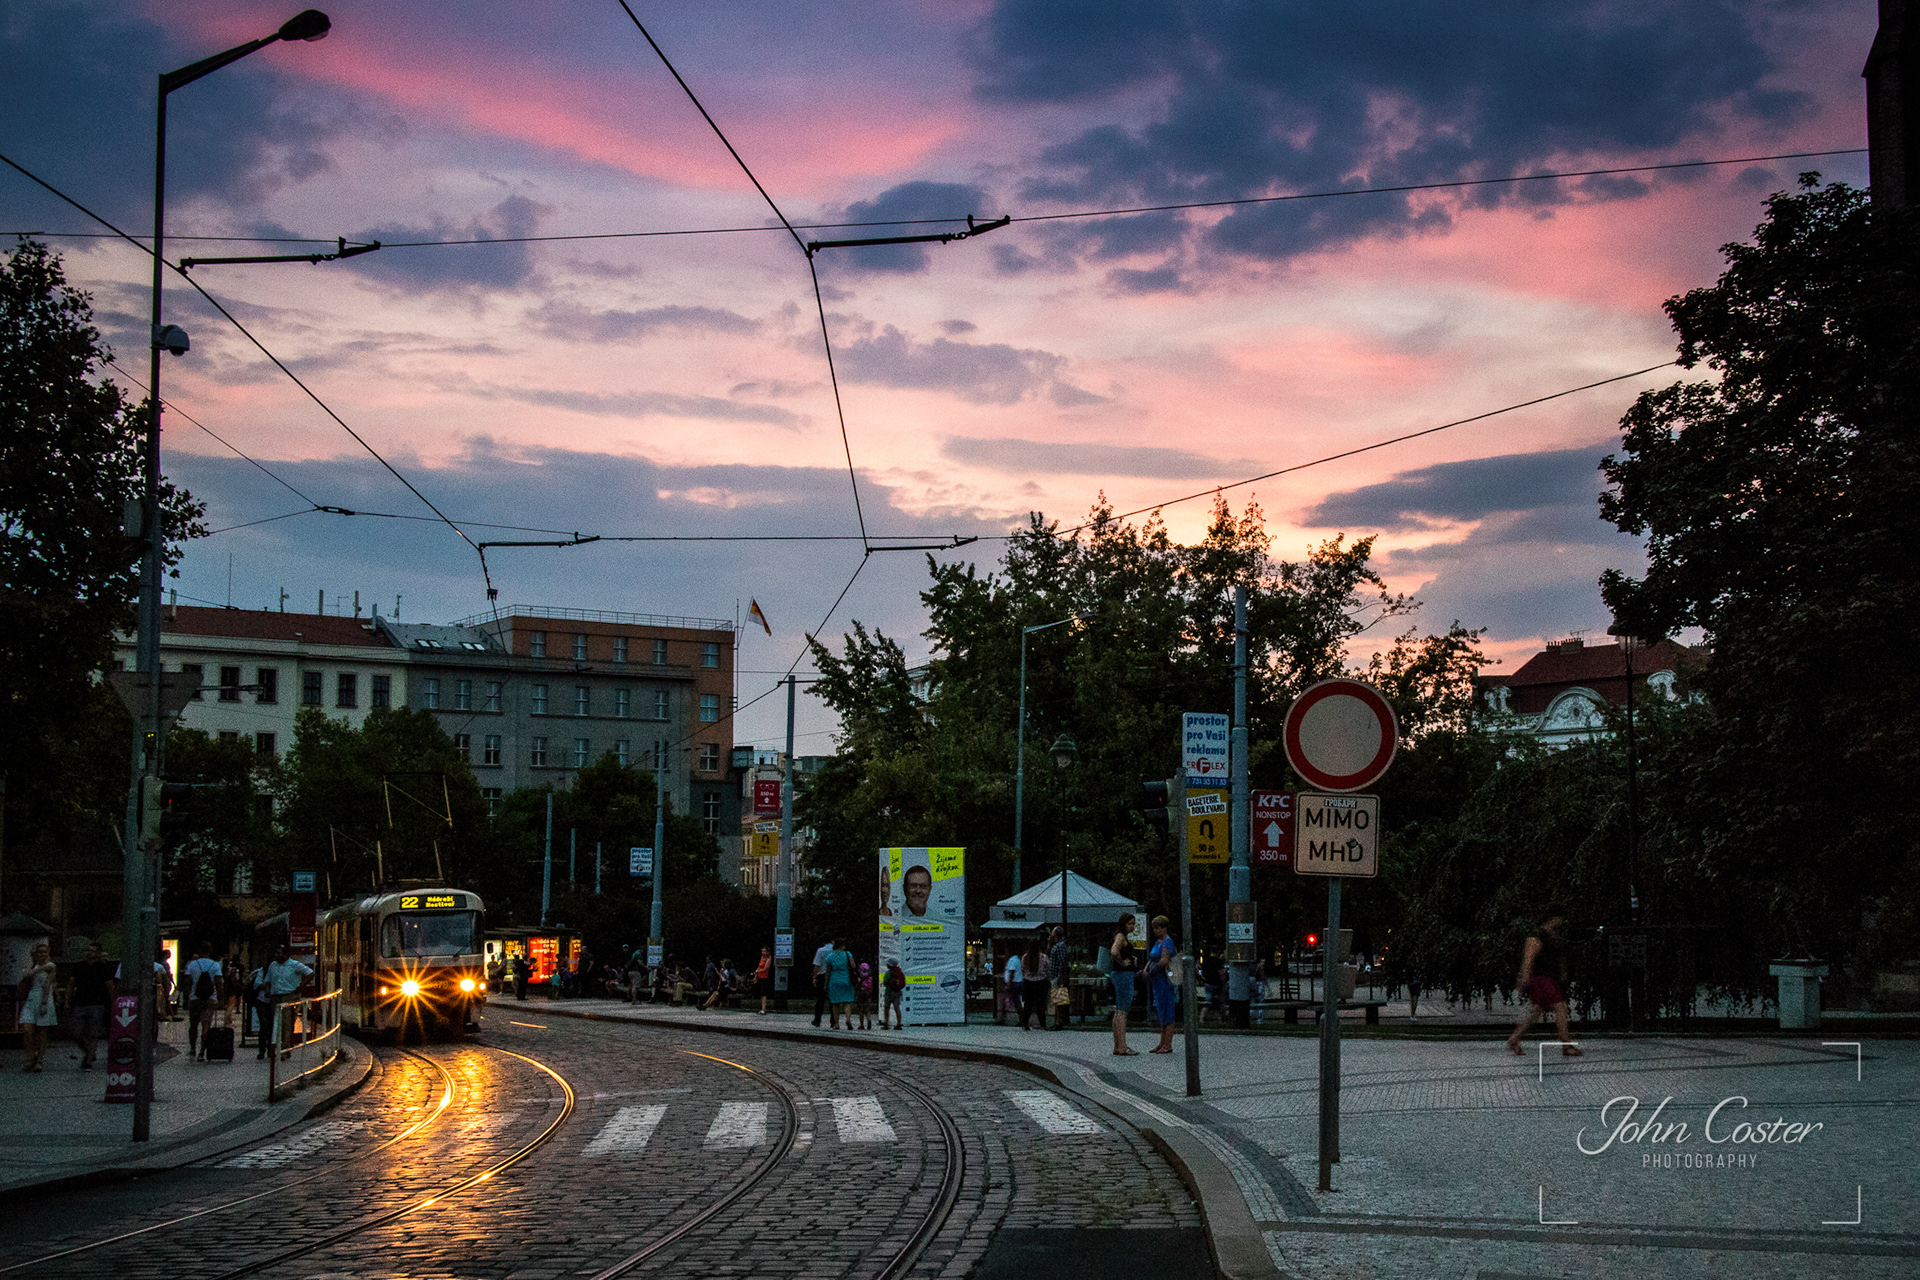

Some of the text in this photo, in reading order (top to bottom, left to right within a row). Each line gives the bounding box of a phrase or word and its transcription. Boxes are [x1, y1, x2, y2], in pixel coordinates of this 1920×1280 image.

[1187, 716, 1226, 727] prostor
[1187, 730, 1226, 741] pro Vaši
[1187, 744, 1225, 755] reklamu
[1188, 795, 1219, 806] BAGETERIE
[1258, 795, 1291, 807] KFC
[1191, 804, 1225, 815] BOULEVARD
[1256, 811, 1291, 819] NONSTOP
[1306, 808, 1369, 829] MIMO
[1260, 850, 1278, 861] 350
[1310, 841, 1363, 862] MHD
[401, 896, 419, 909] 22
